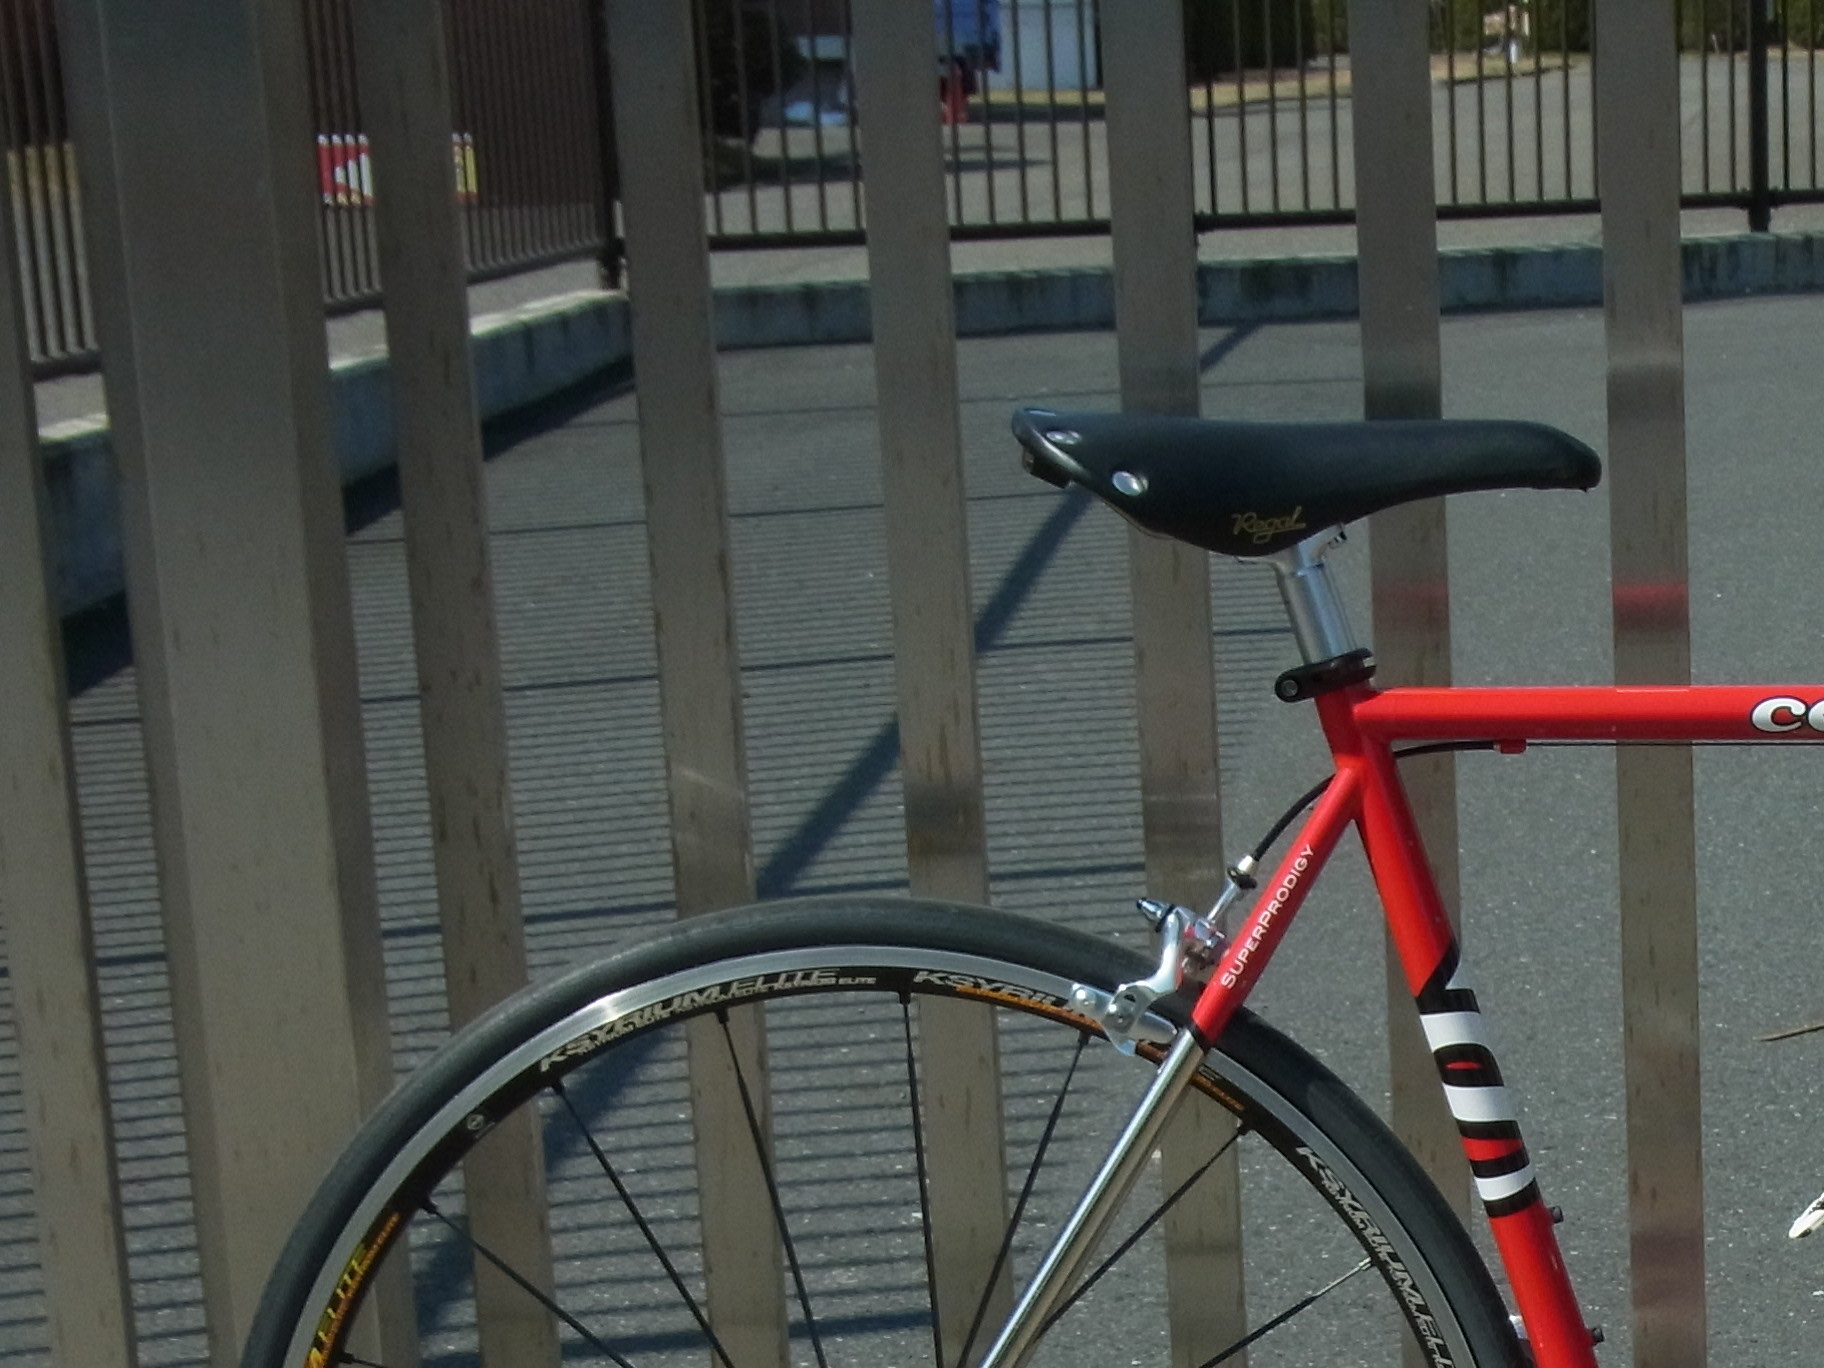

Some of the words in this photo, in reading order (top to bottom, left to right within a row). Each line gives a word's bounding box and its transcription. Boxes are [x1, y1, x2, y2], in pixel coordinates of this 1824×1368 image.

[1231, 505, 1307, 544] Regal
[1220, 843, 1316, 989] SUPERPRODIGY
[535, 984, 723, 1073] KSYRIUM
[1294, 1140, 1425, 1311] KSYRIUM
